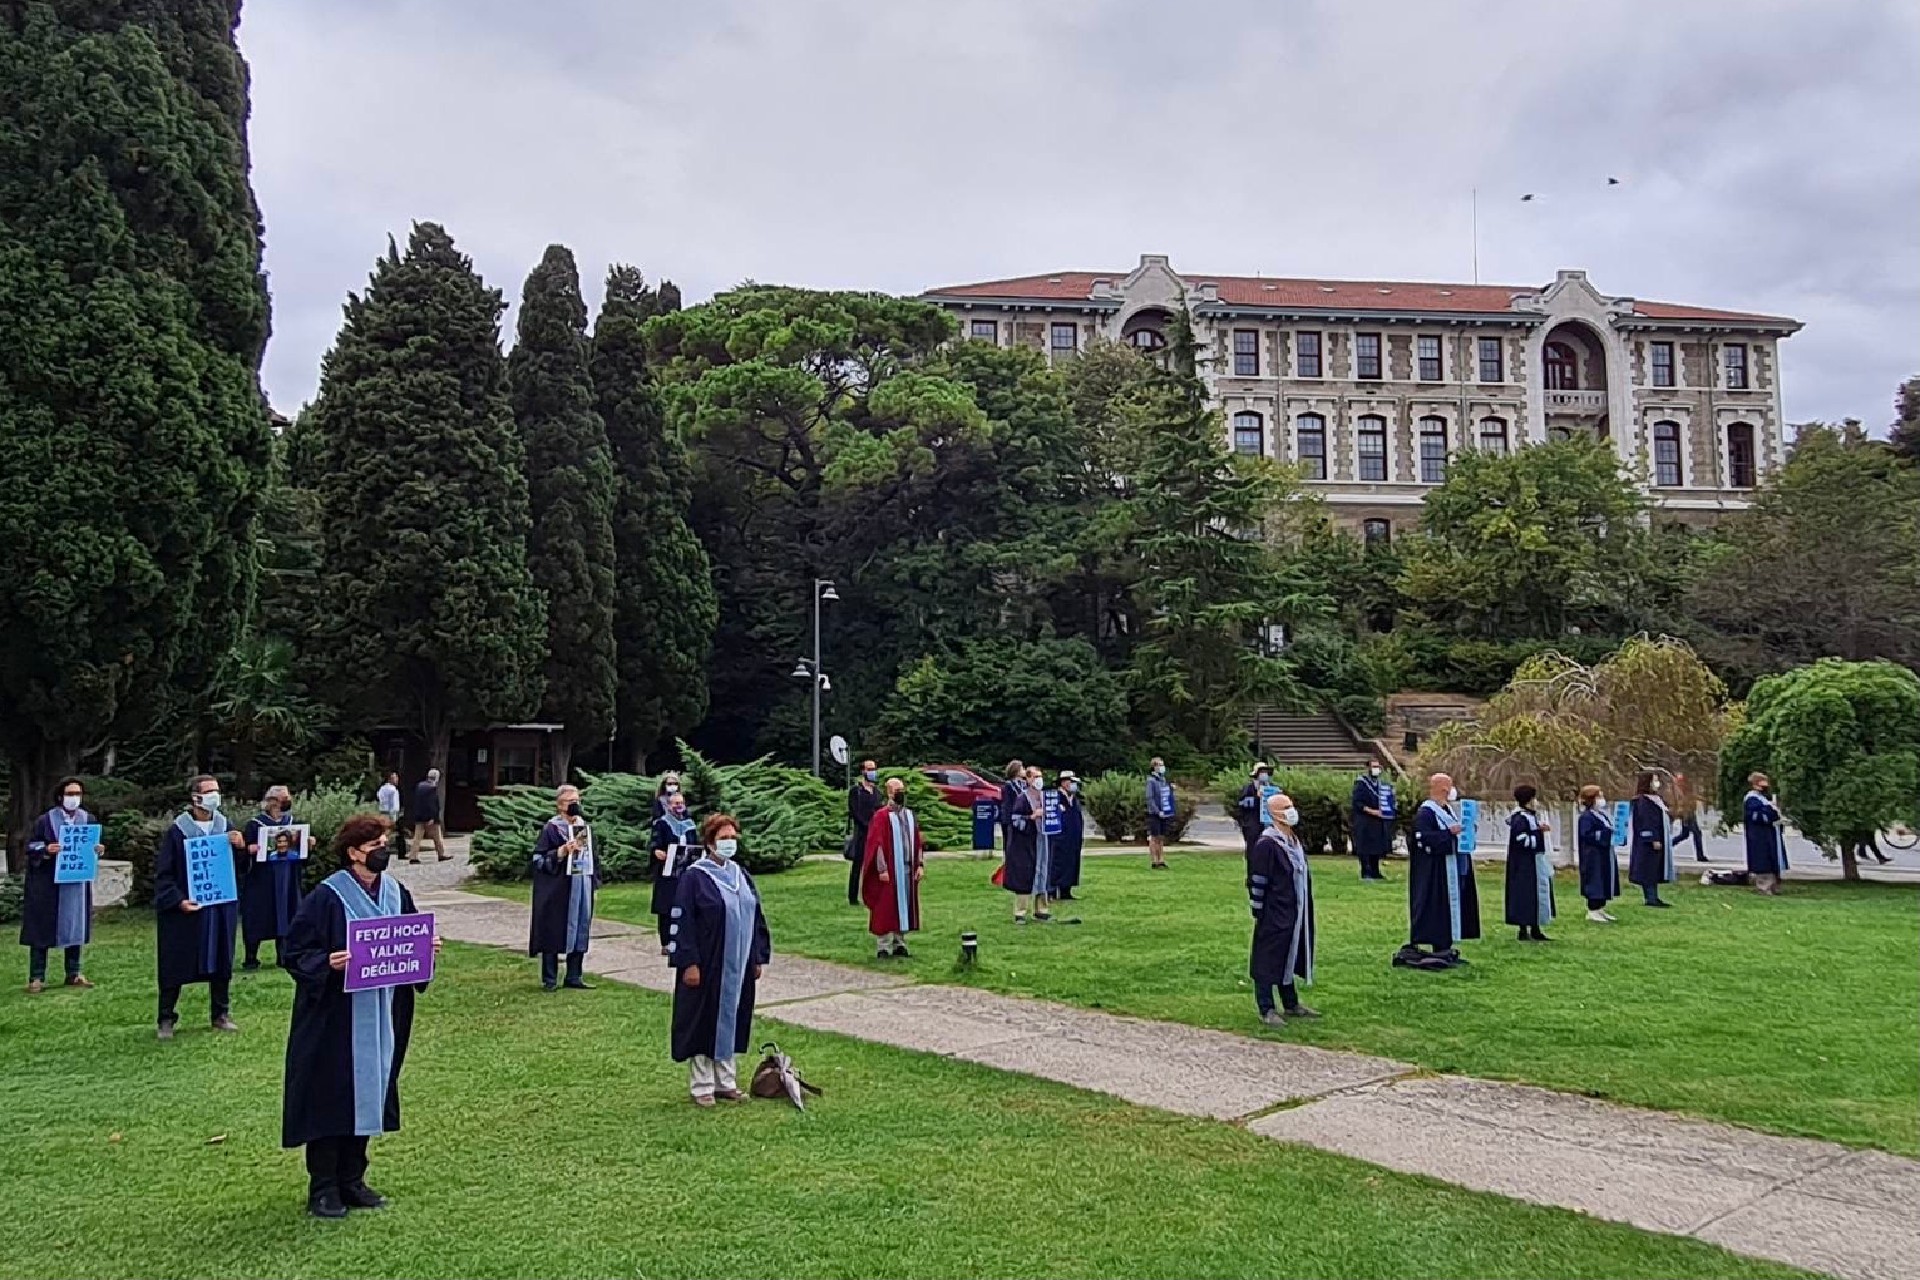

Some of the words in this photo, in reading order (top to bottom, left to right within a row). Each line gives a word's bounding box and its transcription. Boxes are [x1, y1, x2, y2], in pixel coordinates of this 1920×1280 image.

[355, 924, 391, 942] FEYZİ
[393, 924, 429, 938] HOCA
[370, 942, 414, 959] YALNIZ
[361, 958, 419, 979] DEĞİLDİR
